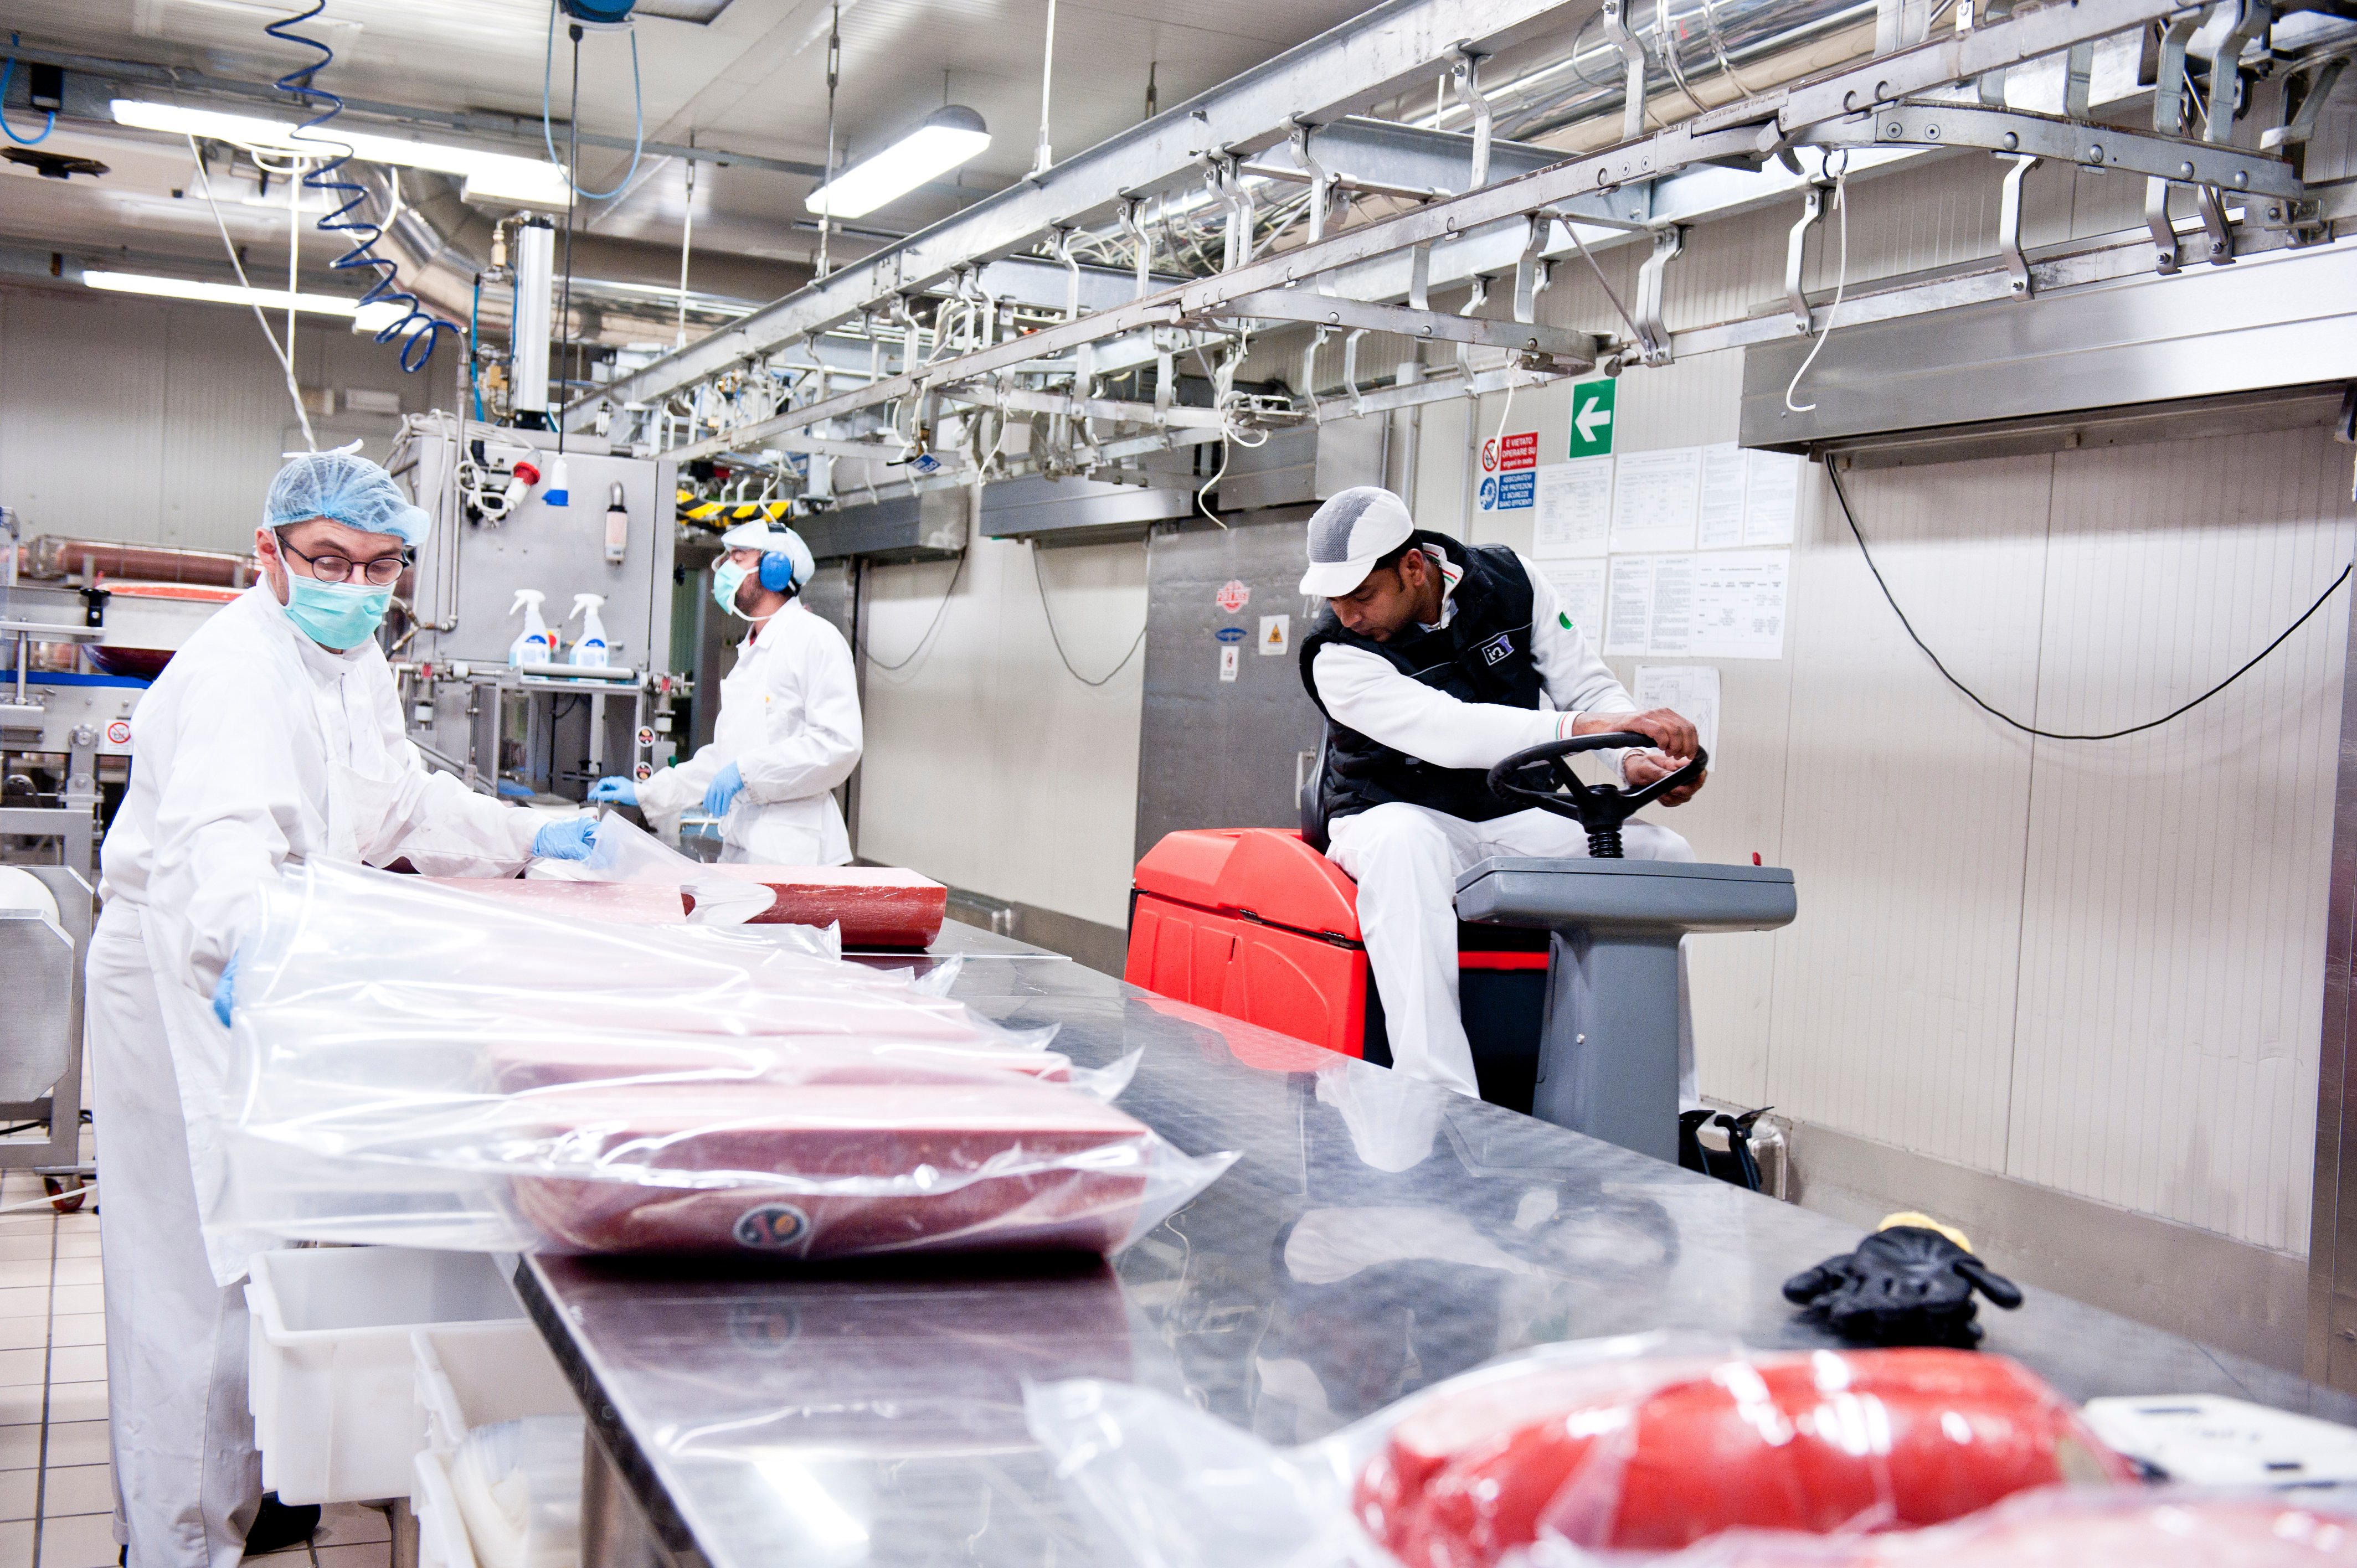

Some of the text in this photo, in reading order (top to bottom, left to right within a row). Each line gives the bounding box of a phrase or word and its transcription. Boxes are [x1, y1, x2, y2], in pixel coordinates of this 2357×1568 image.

[1511, 436, 1533, 446] VIETATO
[1502, 446, 1536, 458] OPERARE SU
[1503, 474, 1532, 483] ASSICURATEVI
[1509, 482, 1533, 491] PROTEZIONI
[1507, 491, 1529, 499] SICUREZZE
[1512, 498, 1532, 507] EFFICIENTI
